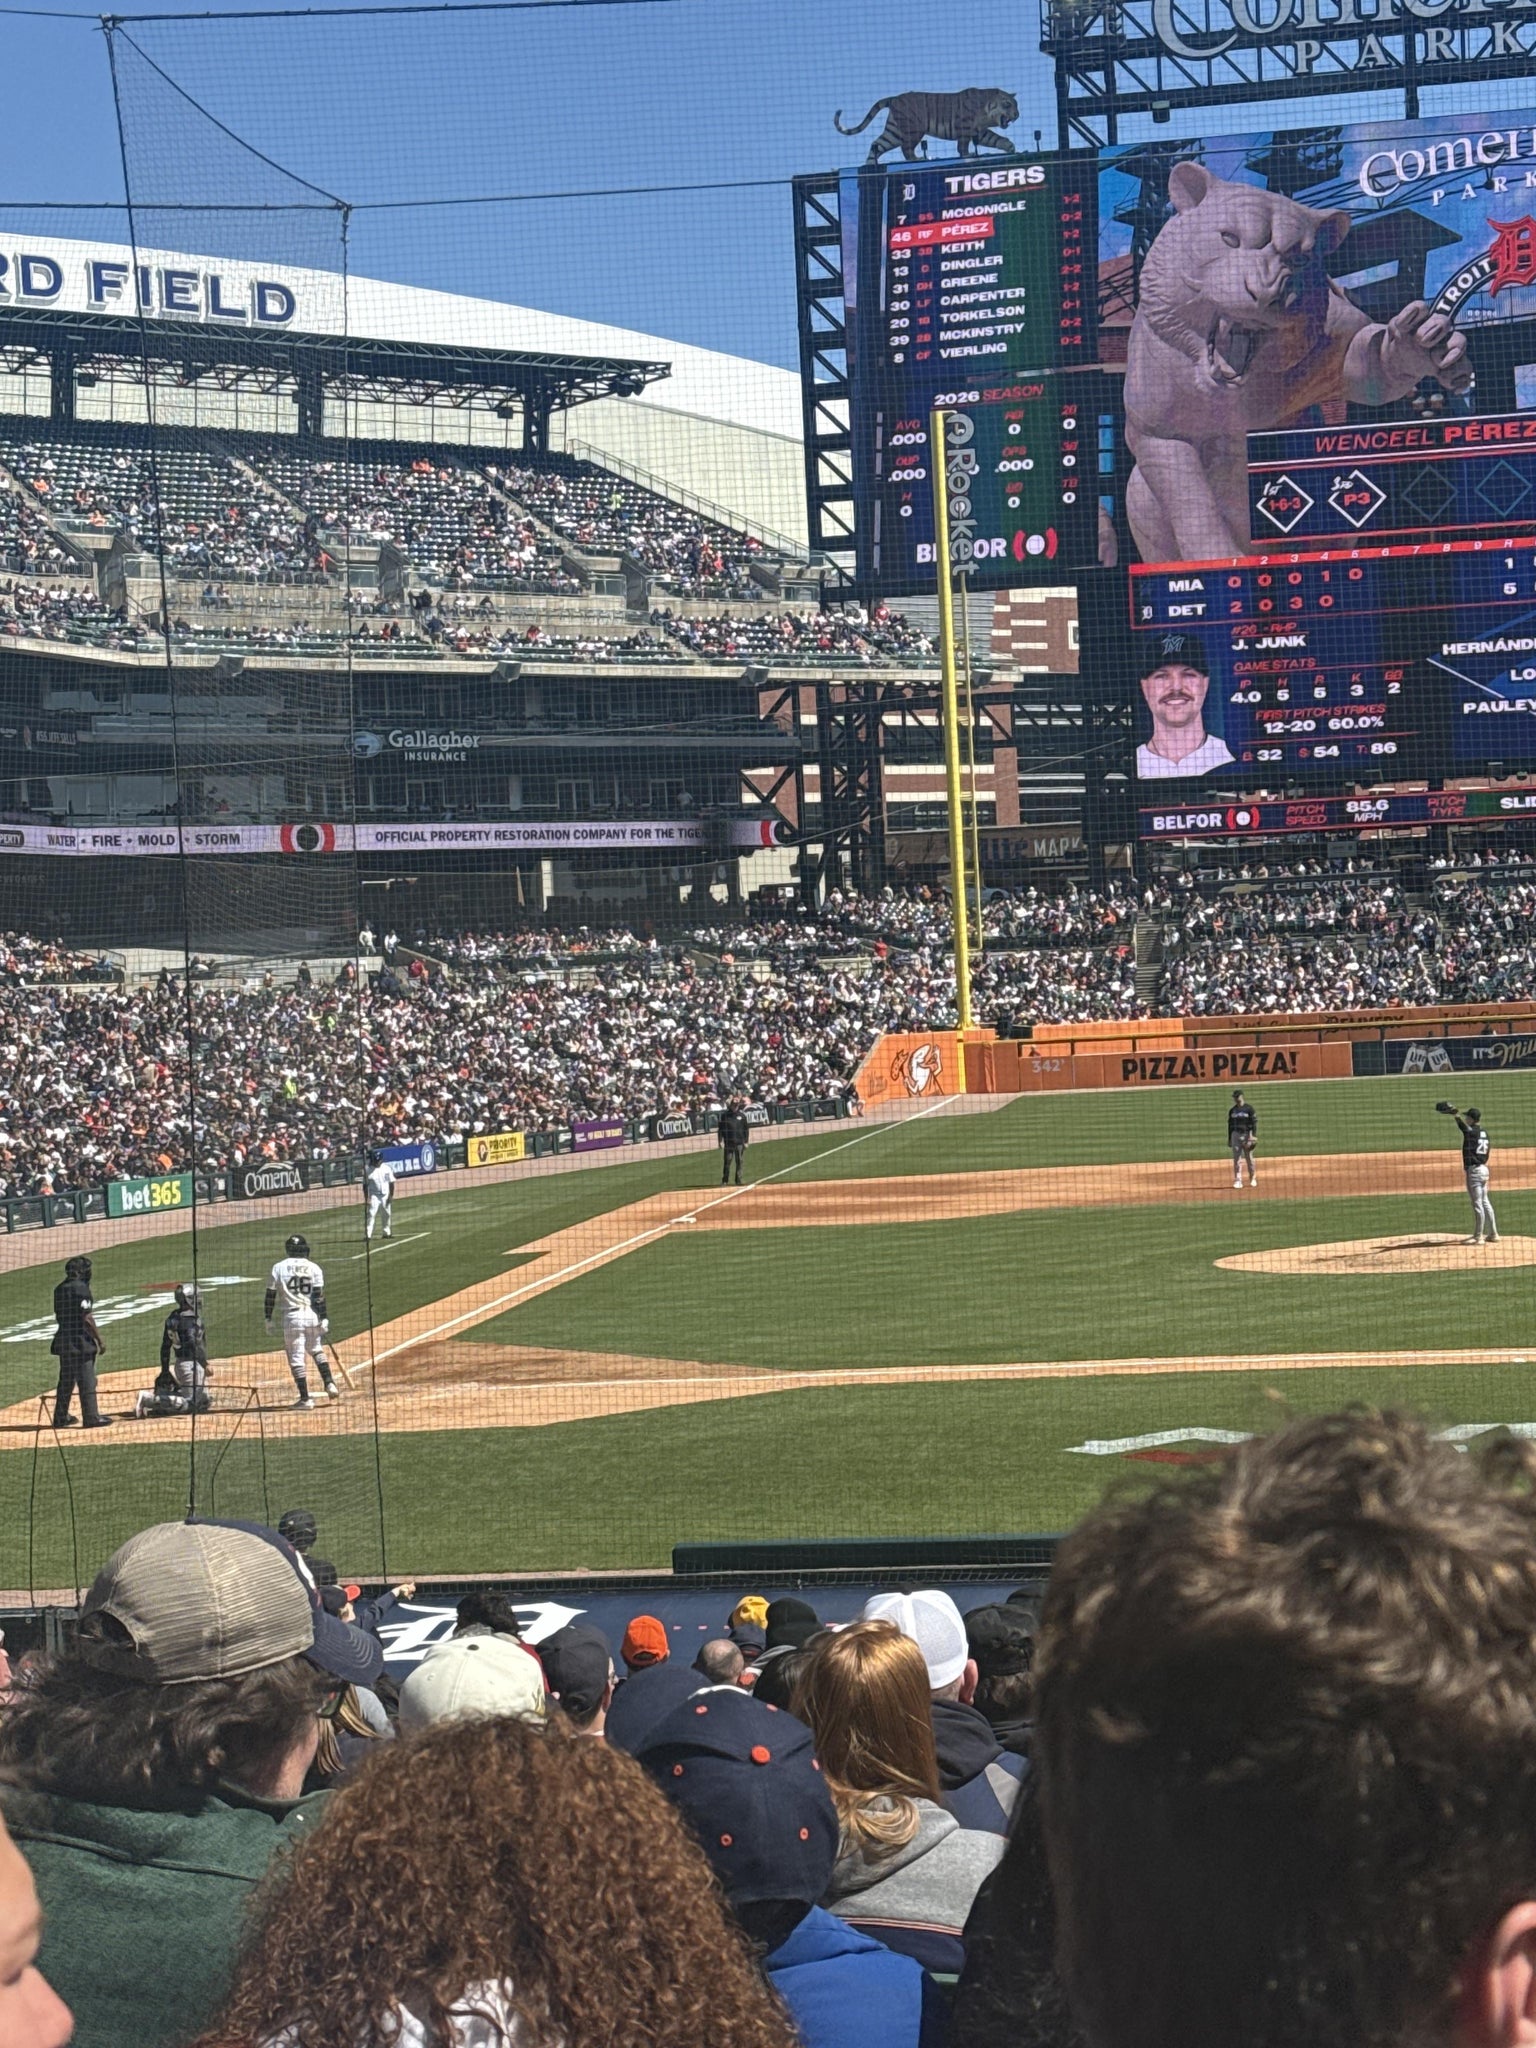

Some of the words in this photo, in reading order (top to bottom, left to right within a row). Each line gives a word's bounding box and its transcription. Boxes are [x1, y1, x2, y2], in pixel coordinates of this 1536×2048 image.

[1296, 20, 1522, 74] PARK
[945, 165, 1046, 194] TIGERS
[897, 215, 907, 225] 7
[942, 200, 1026, 220] MCGONIGLE
[891, 232, 912, 242] 46
[918, 230, 934, 240] RF
[941, 221, 989, 238] PÉREZ
[891, 249, 911, 260] 33
[941, 240, 985, 255] KEITH
[893, 266, 909, 277] 13
[941, 256, 1003, 271] DINGLER
[0, 252, 63, 298] D
[88, 259, 296, 325] FIELD
[892, 283, 909, 294] 31
[941, 273, 998, 289] GREENE
[890, 300, 910, 312] 30
[940, 288, 1025, 306] CARPENTER
[890, 318, 910, 329] 20
[940, 305, 1025, 323] TORKELSON
[889, 335, 910, 346] 39
[940, 323, 1024, 341] MCKINSTRY
[893, 353, 904, 364] 8
[939, 343, 1007, 359] VIERLING
[935, 391, 980, 406] 2026
[982, 384, 1044, 400] SEASON
[888, 432, 927, 446] .000
[1008, 423, 1021, 435] 0
[1063, 418, 1076, 430] 0
[1315, 431, 1434, 452] WENCEEL
[1444, 420, 1536, 444] PÉREZ
[888, 468, 926, 482] .000
[994, 459, 1034, 473] .000
[1062, 455, 1076, 467] 0
[900, 505, 912, 517] 0
[1008, 496, 1020, 508] 0
[1062, 492, 1076, 504] 0
[1344, 492, 1370, 507] P3
[947, 447, 981, 577] Rocket
[916, 538, 1007, 563] BOR
[1260, 556, 1268, 565] 2
[1291, 554, 1299, 563] 3
[1321, 552, 1330, 561] 4
[1382, 548, 1390, 556] 6
[1413, 546, 1421, 554] 7
[1443, 543, 1451, 552] 8
[1169, 579, 1204, 592] MIA
[1228, 576, 1242, 588] 0
[1257, 574, 1272, 587] 0
[1288, 572, 1302, 585] 0
[1321, 570, 1330, 582] 1
[1349, 568, 1363, 581] 0
[1505, 558, 1514, 569] 1
[1169, 603, 1206, 617] DET
[1230, 601, 1243, 614] 2
[1258, 598, 1273, 611] 0
[1289, 596, 1303, 610] 3
[1319, 595, 1334, 608] 0
[1503, 582, 1517, 595] 5
[1271, 623, 1297, 632] RHP
[1232, 639, 1248, 650] J.
[1255, 634, 1306, 649] JUNK
[1442, 637, 1536, 655] HERNÁND
[1233, 660, 1270, 672] GAME
[1273, 657, 1316, 670] STATS
[1352, 673, 1362, 682] K
[1230, 691, 1262, 703] 4.0
[1276, 689, 1290, 701] 5
[1313, 686, 1327, 698] 5
[1350, 684, 1364, 697] 3
[1388, 682, 1401, 694] 2
[1256, 709, 1292, 721] FIRST
[1293, 706, 1331, 719] PITCH
[1334, 703, 1387, 716] STRIKES
[1463, 698, 1536, 714] PAULEY
[1264, 719, 1316, 734] 12-20
[1328, 716, 1384, 730] 60.0%
[388, 729, 480, 751] Gallagher
[405, 752, 467, 762] INSURANCE
[1257, 748, 1283, 761] 32
[1314, 745, 1340, 758] 54
[1370, 741, 1397, 754] 86
[1286, 804, 1325, 815] PITCH
[1345, 799, 1390, 812] 85.6
[1428, 795, 1467, 807] PITCH
[1153, 813, 1222, 831] BELFOR
[1285, 815, 1327, 826] SPEED
[1354, 812, 1383, 823] MPH
[1431, 806, 1464, 817] TYPE
[47, 834, 76, 847] WATER
[92, 835, 122, 847] FIRE
[138, 834, 175, 846] MOLD
[195, 833, 240, 845] STORM
[375, 831, 428, 842] OFFICIAL
[431, 830, 491, 841] PROPERTY
[494, 829, 570, 841] RESTORATION
[573, 829, 627, 840] COMPANY
[631, 828, 651, 839] FOR
[655, 828, 674, 839] THE
[1273, 872, 1393, 891] CHEVROLET
[1490, 869, 1536, 879] CHE
[1122, 1055, 1205, 1081] PIZZA!
[1213, 1051, 1298, 1076] PIZZA!
[121, 1181, 181, 1210] bet365
[287, 1276, 312, 1295] 46
